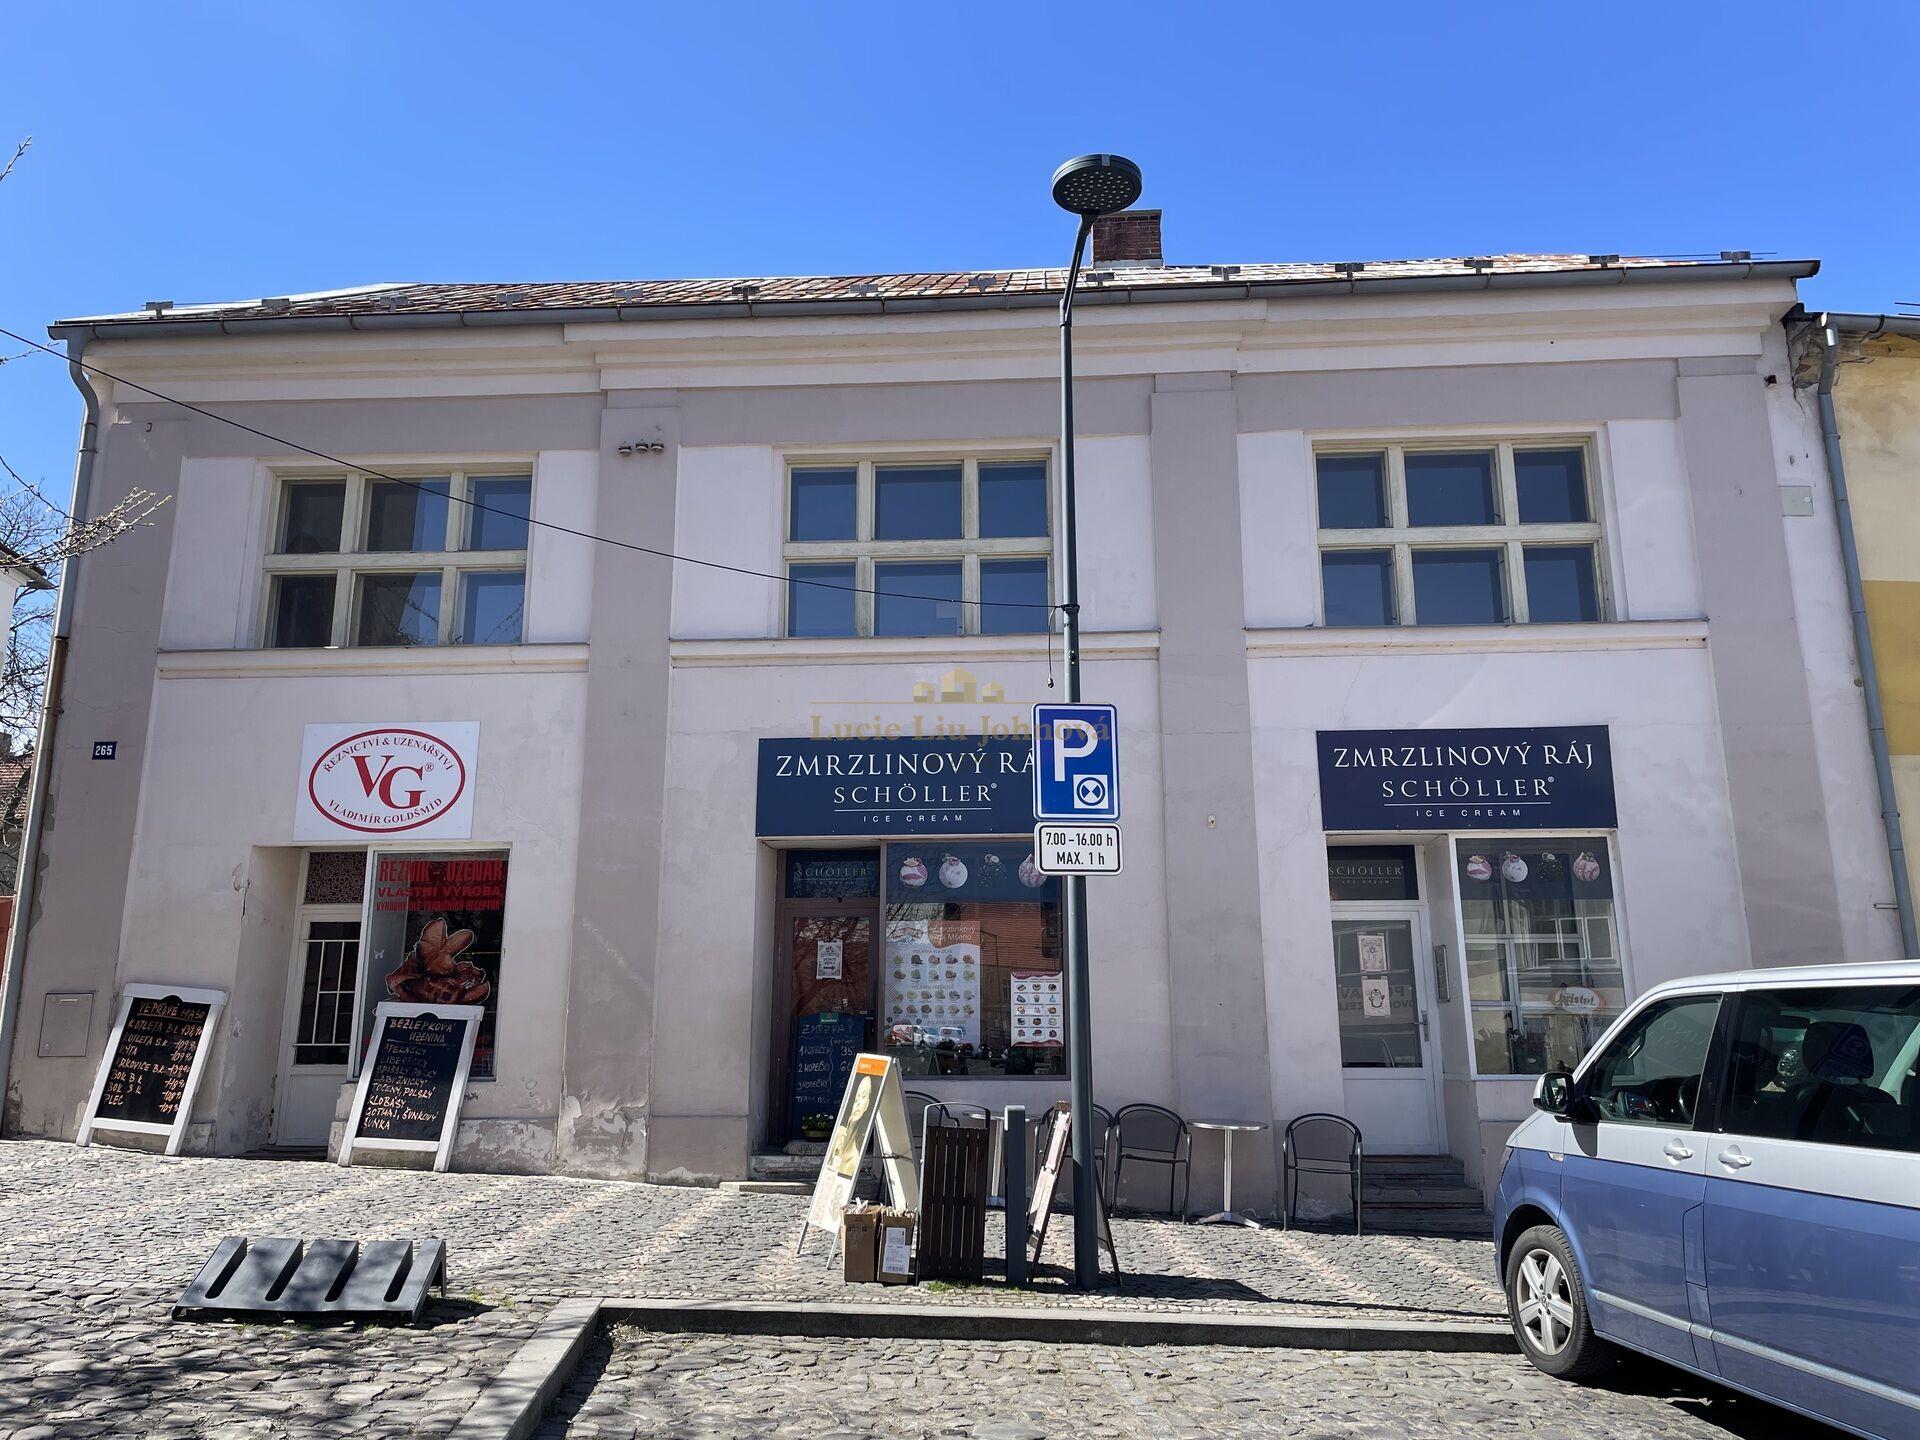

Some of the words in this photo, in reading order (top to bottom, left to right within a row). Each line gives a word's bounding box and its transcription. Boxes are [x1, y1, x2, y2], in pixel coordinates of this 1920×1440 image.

[95, 745, 113, 756] 265
[324, 737, 379, 773] ŘEZNICTVÍ
[393, 737, 455, 770] UZENÁŘSTVÍ
[1054, 719, 1098, 782] P
[1333, 741, 1532, 768] ZMRZLINOVÝ
[1544, 740, 1593, 770] RÁJ
[776, 748, 987, 777] ZMRZLINOVÝ
[1000, 748, 1033, 774] RÁ
[329, 799, 381, 824] VLADIMÍR
[384, 798, 442, 824] GOLDŠMÍD
[863, 815, 892, 823] ICE
[1416, 809, 1445, 817] ICE
[1461, 809, 1521, 817] CREAM
[1106, 832, 1113, 847] h
[1056, 852, 1084, 866] MAX.
[1089, 852, 1095, 866] 1
[1098, 852, 1105, 866] h
